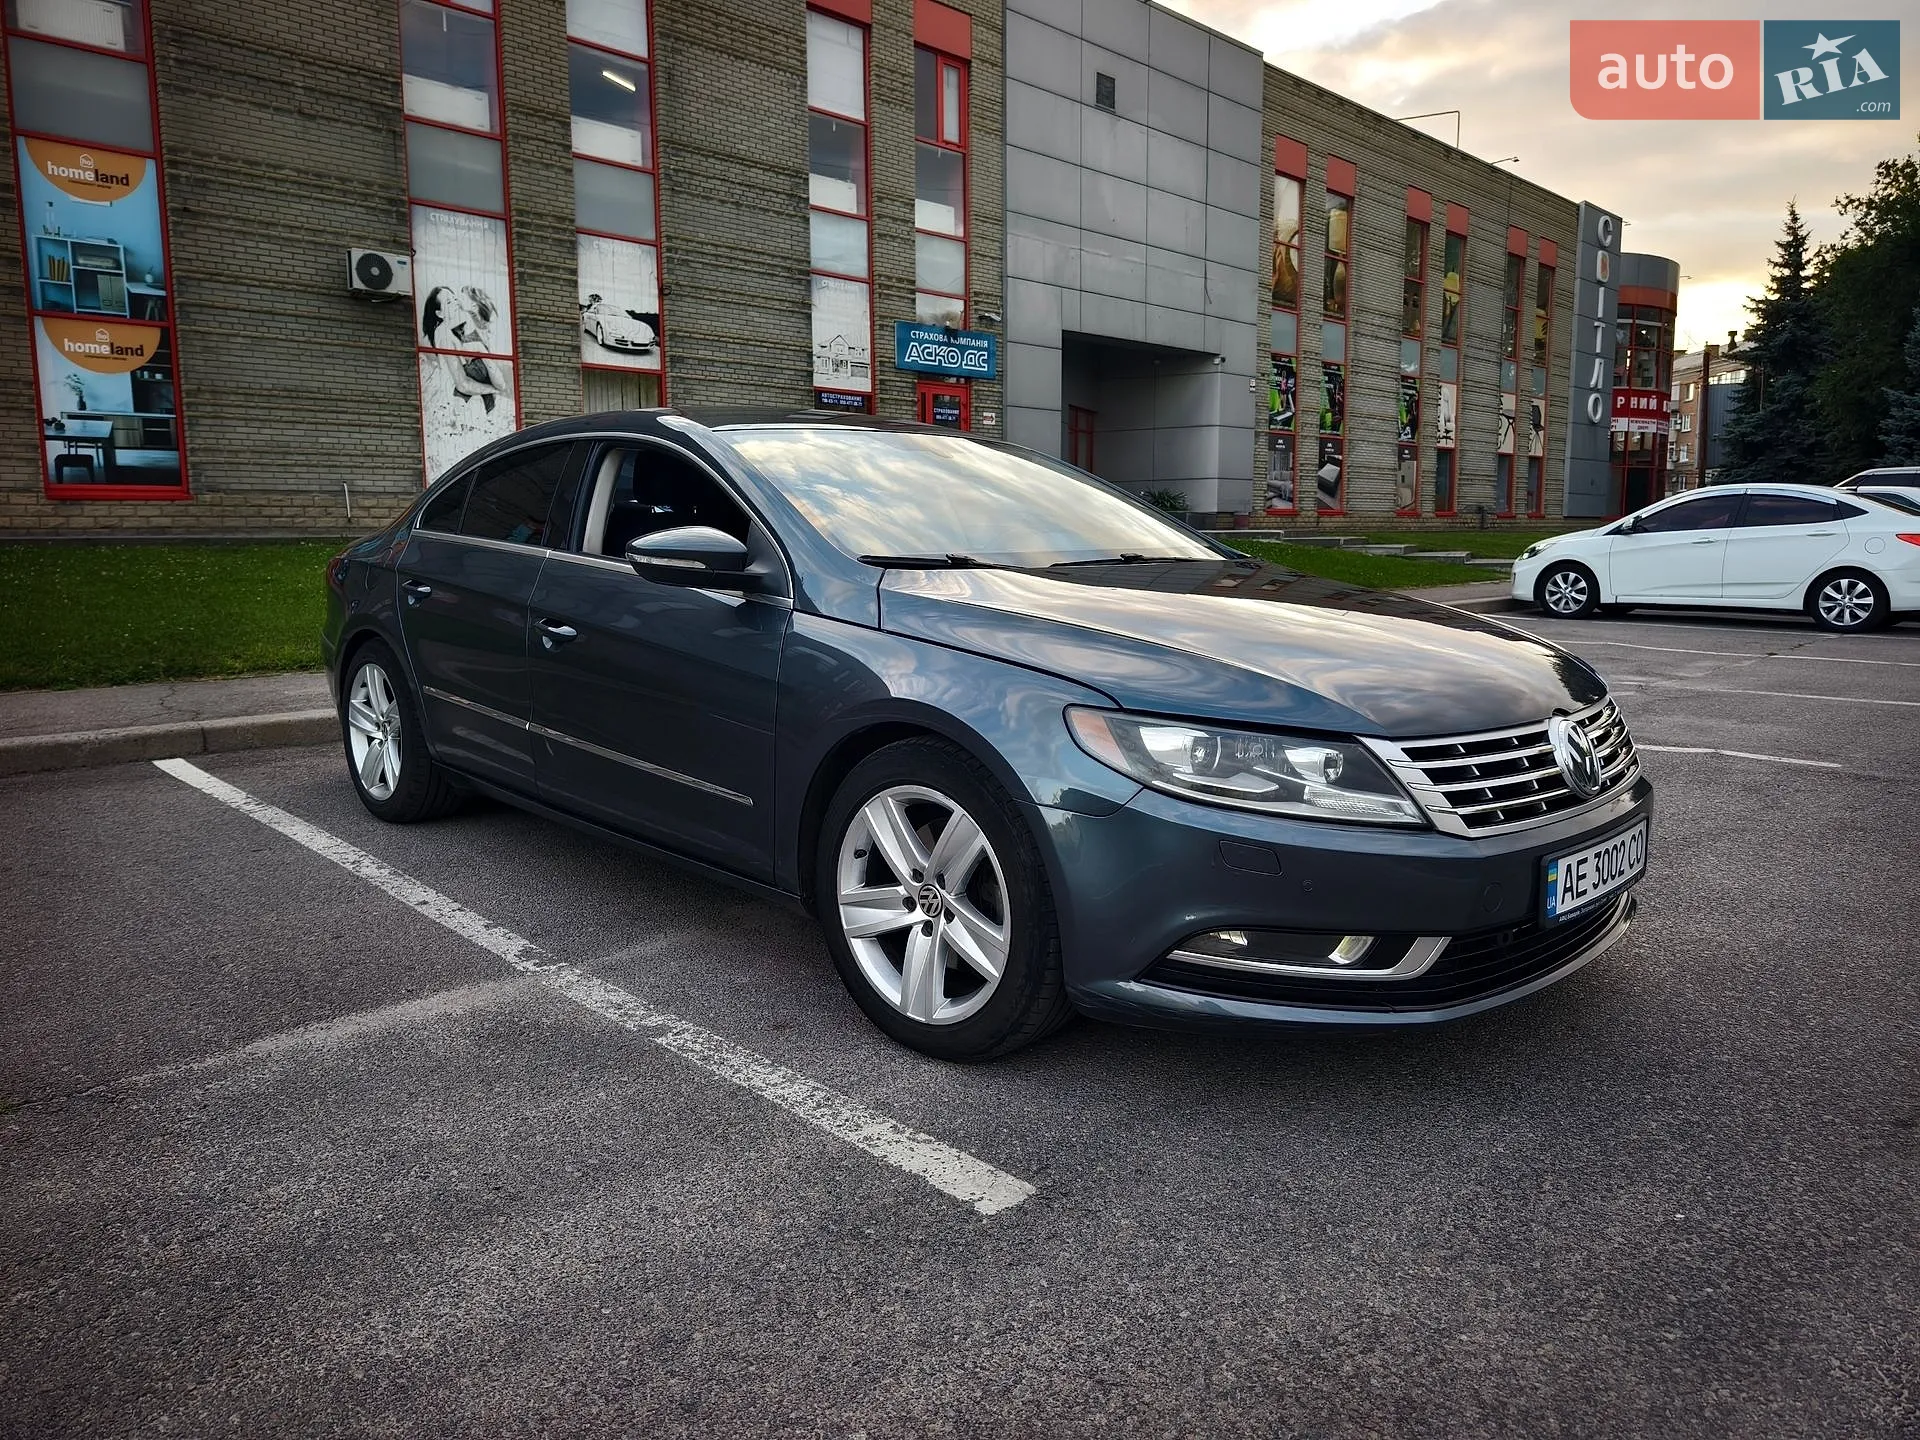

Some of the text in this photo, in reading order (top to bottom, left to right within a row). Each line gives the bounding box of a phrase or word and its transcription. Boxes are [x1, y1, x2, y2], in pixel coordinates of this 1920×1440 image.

[47, 161, 129, 187] homeland
[910, 330, 948, 342] СТРАХОВА
[63, 338, 144, 357] homeland
[904, 341, 988, 372] АСКО ДС
[1561, 856, 1588, 906] AE
[1592, 840, 1626, 890] 3002
[1628, 829, 1643, 870] CO
[1546, 896, 1556, 910] UA
